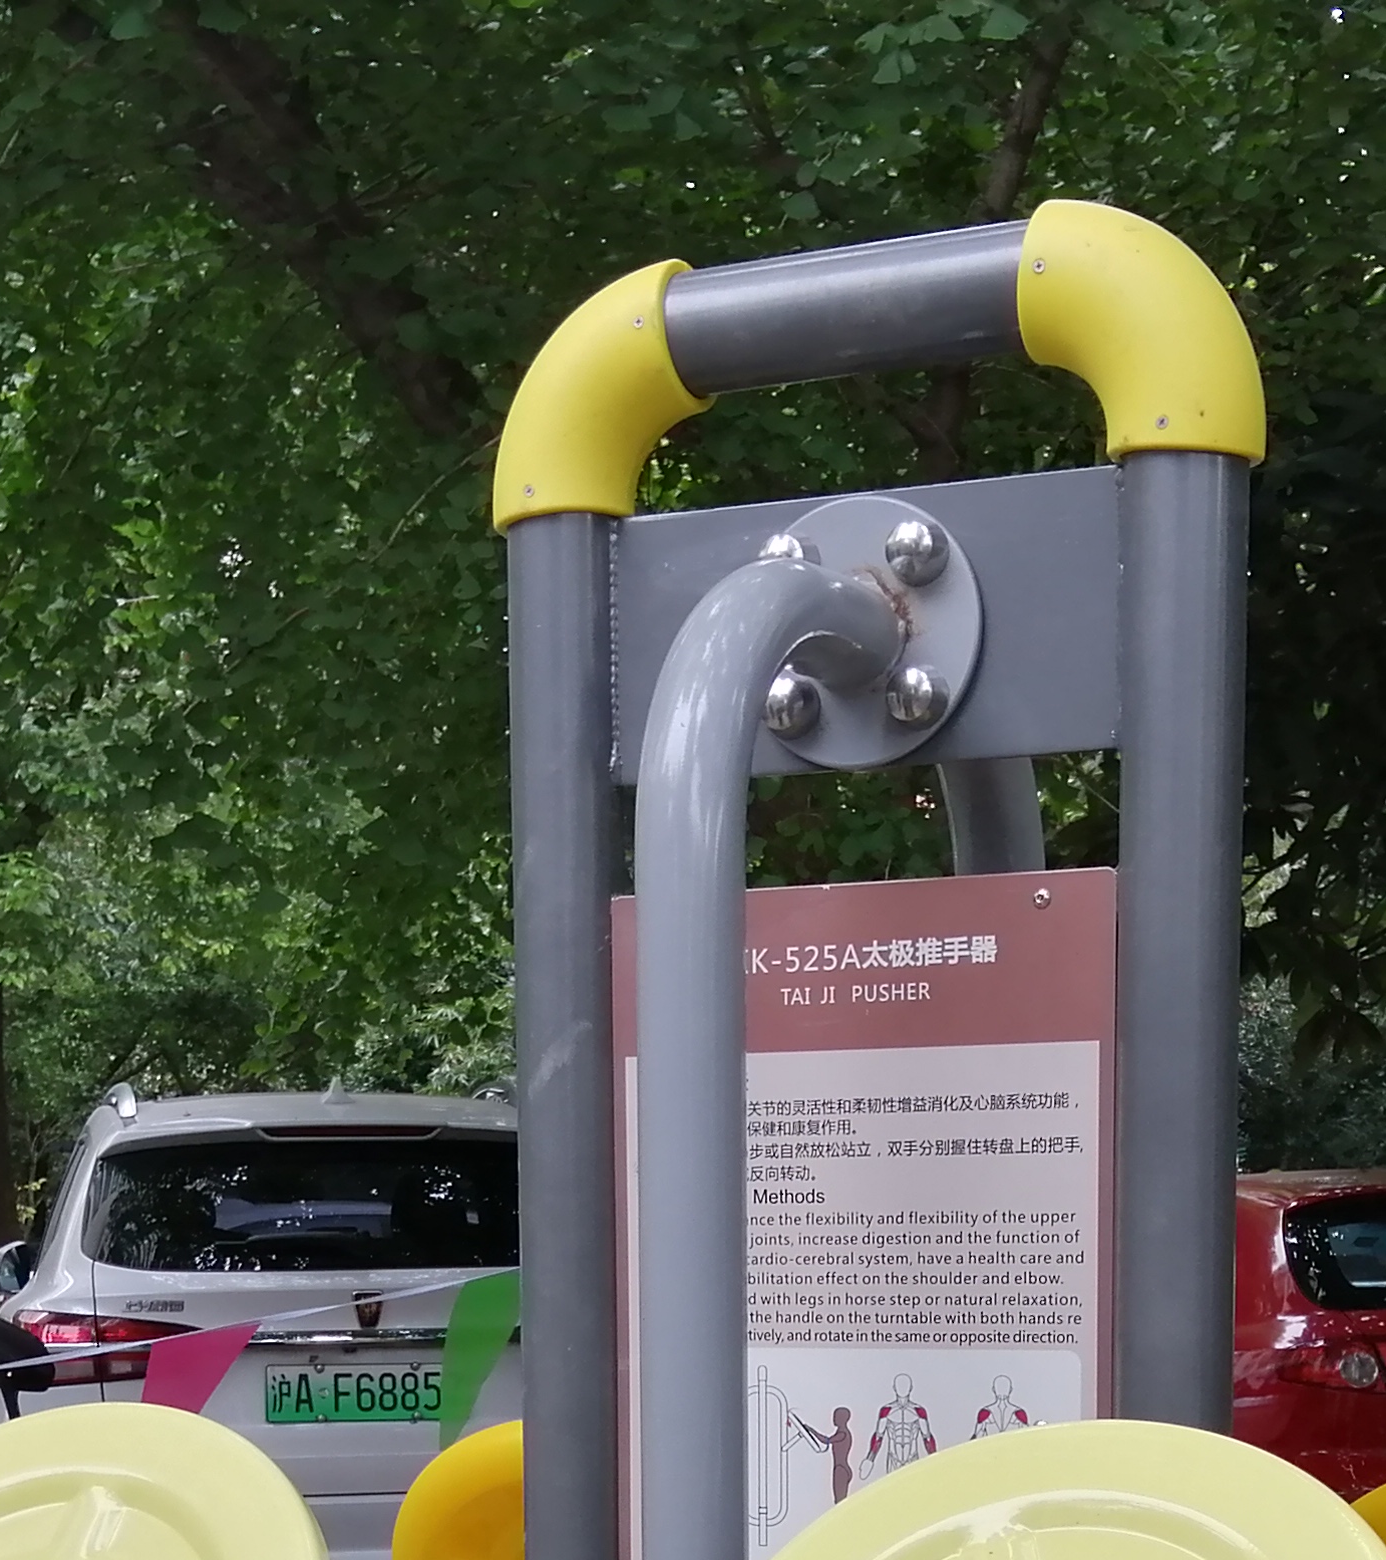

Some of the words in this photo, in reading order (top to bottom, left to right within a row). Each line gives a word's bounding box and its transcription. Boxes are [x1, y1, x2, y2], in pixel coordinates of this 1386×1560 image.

[745, 934, 998, 975] K-525A太极推手器
[780, 986, 811, 1006] TAI
[820, 985, 836, 1005] JI
[851, 981, 931, 1003] PUSHER
[747, 1165, 817, 1183] 反向转动。
[753, 1188, 826, 1205] Methods
[747, 1215, 775, 1226] nce
[778, 1212, 802, 1226] the
[805, 1211, 874, 1229] flexibility
[877, 1211, 904, 1225] and
[909, 1210, 979, 1228] flexibility
[982, 1210, 998, 1225] of
[1002, 1210, 1026, 1224] the
[1030, 1212, 1077, 1227] upper
[748, 1233, 794, 1250] joints,
[798, 1233, 858, 1246] increase
[862, 1231, 932, 1249] digestion
[935, 1231, 963, 1245] and
[967, 1231, 992, 1244] the
[996, 1230, 1060, 1244] function
[1064, 1229, 1080, 1243] of
[858, 1253, 913, 1268] system,
[917, 1252, 952, 1265] have
[956, 1254, 964, 1265] a
[968, 1251, 1015, 1265] health
[1020, 1253, 1052, 1265] care
[1055, 1251, 1085, 1264] and
[817, 1272, 858, 1285] effect
[862, 1274, 881, 1285] on
[885, 1272, 908, 1285] the
[912, 1272, 978, 1285] shoulder
[982, 1272, 1010, 1285] and
[1014, 1271, 1064, 1285] elbow.
[760, 1293, 791, 1305] with
[795, 1293, 824, 1308] legs
[828, 1293, 841, 1305] in
[845, 1293, 886, 1306] horse
[889, 1295, 921, 1308] step
[924, 1296, 940, 1306] or
[944, 1293, 998, 1306] natural
[1001, 1293, 1083, 1308] relaxation,
[749, 1311, 772, 1324] the
[775, 1310, 823, 1324] handle
[826, 1313, 845, 1324] on
[848, 1311, 871, 1324] the
[874, 1311, 942, 1324] turntable
[945, 1311, 977, 1325] with
[980, 1311, 1015, 1325] both
[1018, 1311, 1064, 1325] hands
[1067, 1314, 1082, 1325] re
[787, 1329, 811, 1342] and
[814, 1330, 854, 1342] rotate
[856, 1330, 869, 1342] in
[871, 1330, 892, 1342] the
[894, 1332, 931, 1343] same
[932, 1332, 948, 1343] or
[949, 1331, 1010, 1347] opposite
[1012, 1330, 1079, 1344] direction.
